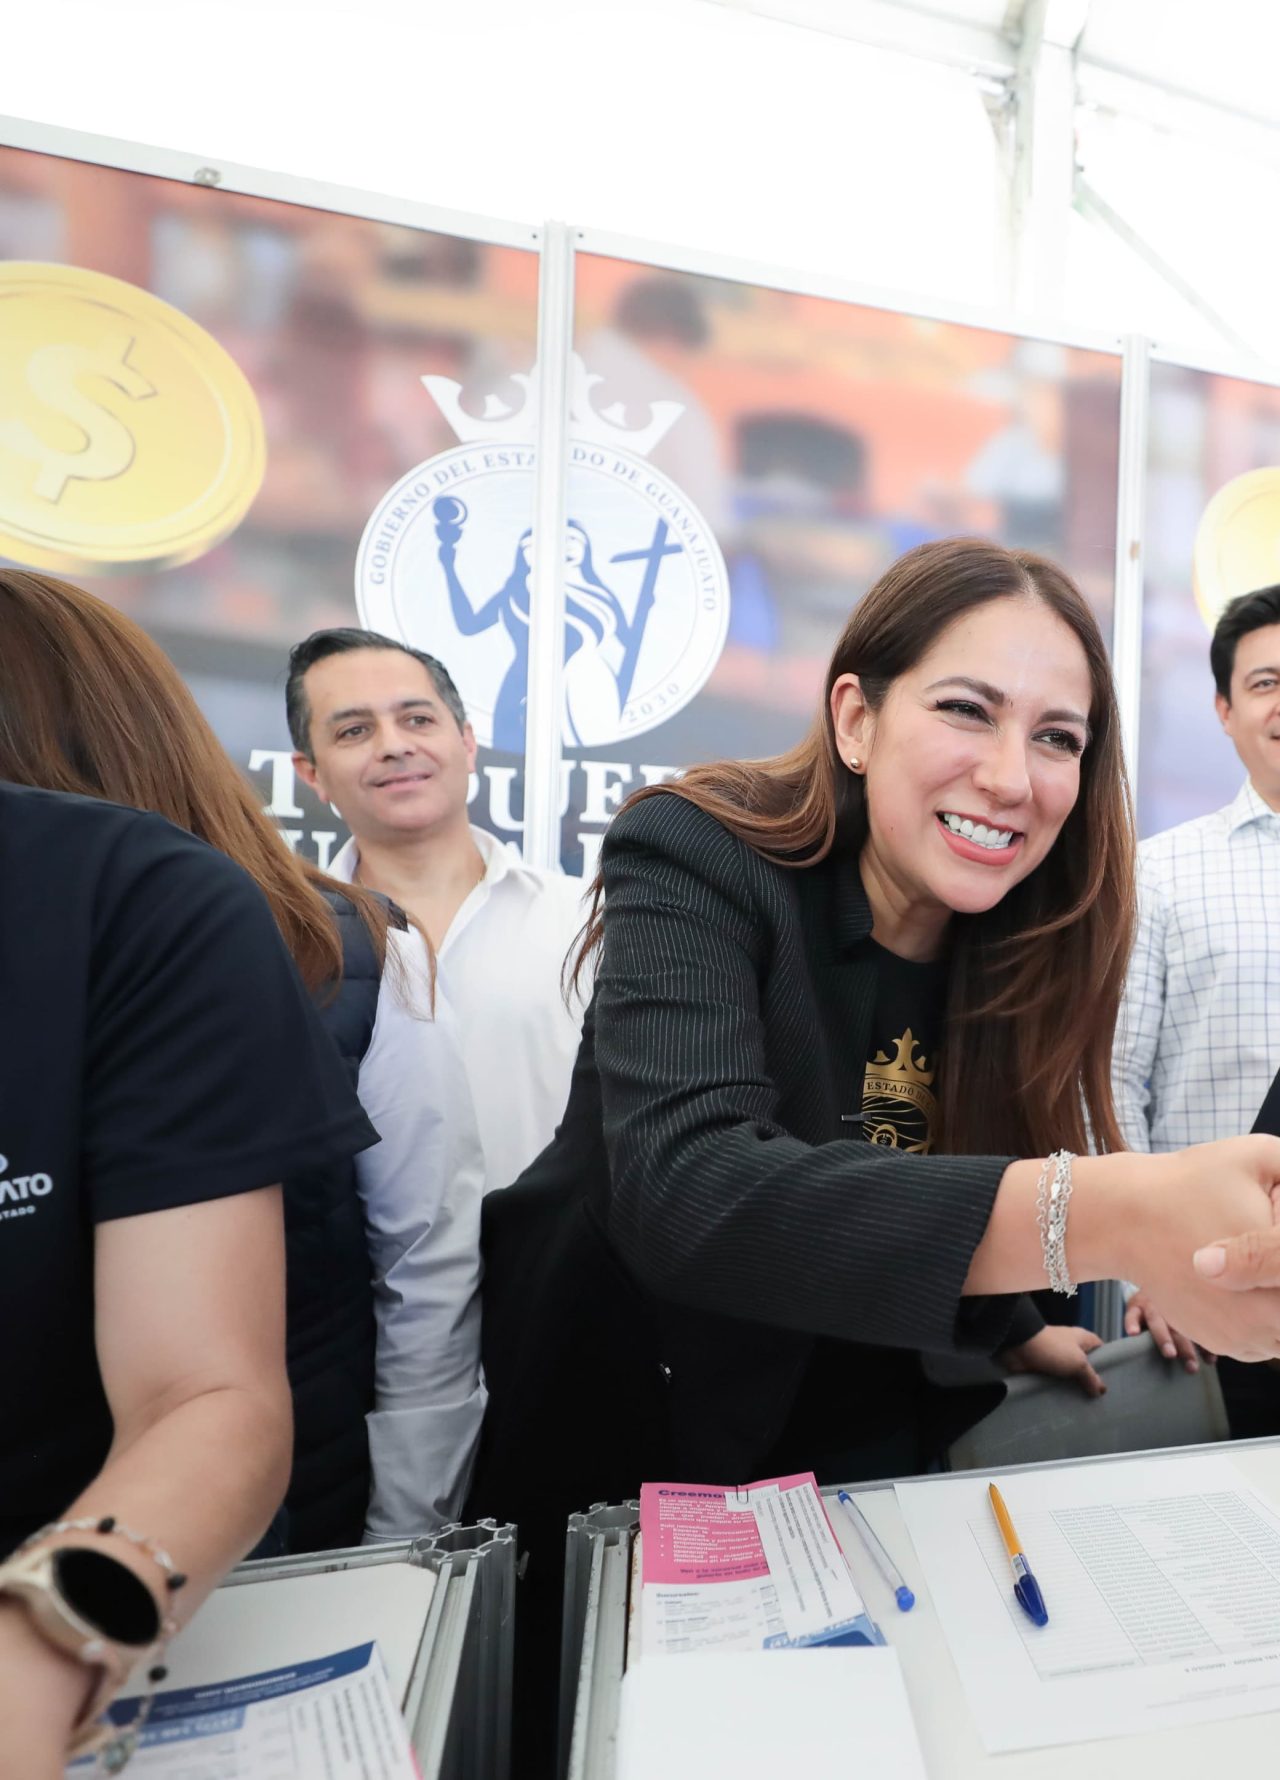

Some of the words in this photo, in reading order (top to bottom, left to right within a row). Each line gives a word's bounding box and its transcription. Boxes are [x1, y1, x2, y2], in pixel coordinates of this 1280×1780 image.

[370, 482, 431, 585] GOBIERNO
[433, 459, 478, 485] DEL
[613, 460, 641, 483] DE
[645, 481, 717, 612] GUANAJUATO
[624, 682, 679, 722] 2030
[866, 1081, 915, 1096] ESTADO
[658, 1489, 726, 1499] Creemo
